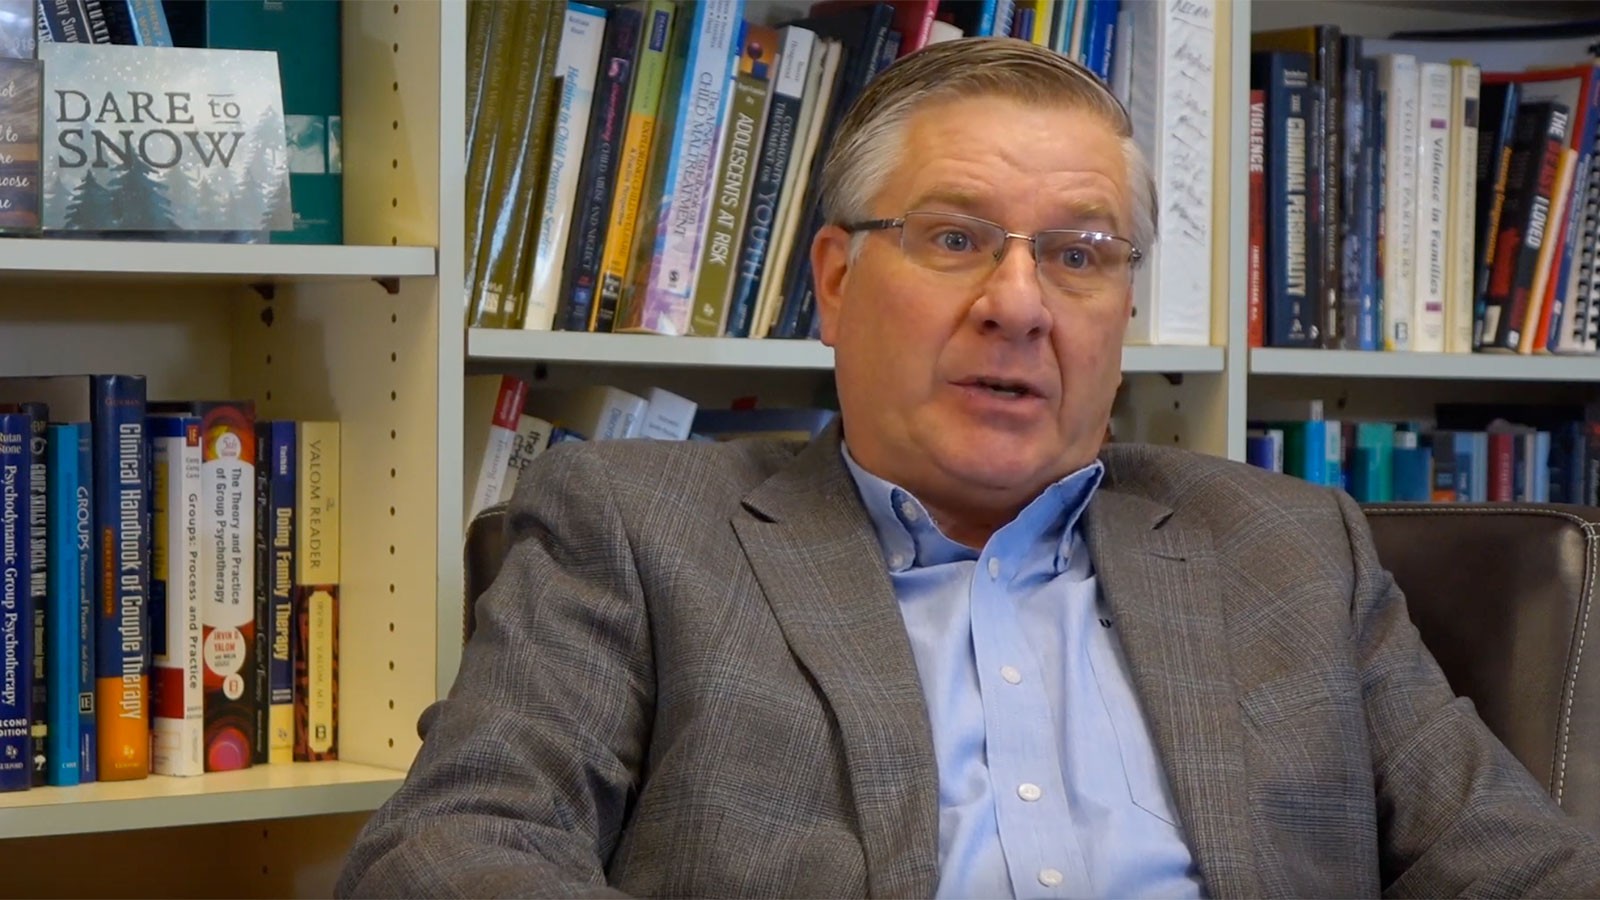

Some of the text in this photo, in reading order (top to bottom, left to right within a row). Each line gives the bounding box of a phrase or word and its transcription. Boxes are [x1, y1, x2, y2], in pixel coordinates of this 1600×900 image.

[54, 89, 241, 124] DARE to
[560, 65, 580, 110] Helping
[707, 90, 719, 110] The
[57, 128, 246, 169] SNOW
[554, 125, 570, 156] Child
[672, 70, 713, 238] CHILD MALTREATMENT
[771, 114, 792, 184] COMMUNITY
[1249, 103, 1264, 172] VIOLENCE
[1287, 117, 1306, 192] CRIMINAL
[1547, 109, 1568, 139] THE
[543, 158, 564, 213] Protective
[721, 113, 755, 208] ADOLESCENTS
[709, 229, 732, 266] RISK
[717, 208, 735, 227] AT
[742, 188, 777, 281] YOUTH
[1287, 194, 1306, 296] PERSONALITY
[1428, 138, 1444, 296] Violence in Families
[1524, 203, 1547, 249] LOVED
[31, 464, 46, 597] GROUP SKILLS IN SOCIAL WORK
[77, 486, 90, 551] GROUPS
[213, 467, 227, 605] of Group Psychotherapy
[228, 467, 242, 605] The Theory and Practice
[309, 440, 322, 569] YALOM READER
[1, 465, 18, 707] Psychodynamic Group Psychotherapy
[118, 423, 143, 720] Clinical Handbook of Couple Therapy
[187, 493, 198, 689] Groups: Process and Practice
[274, 507, 292, 661] Doing Family Therapy
[0, 728, 27, 737] DITION
